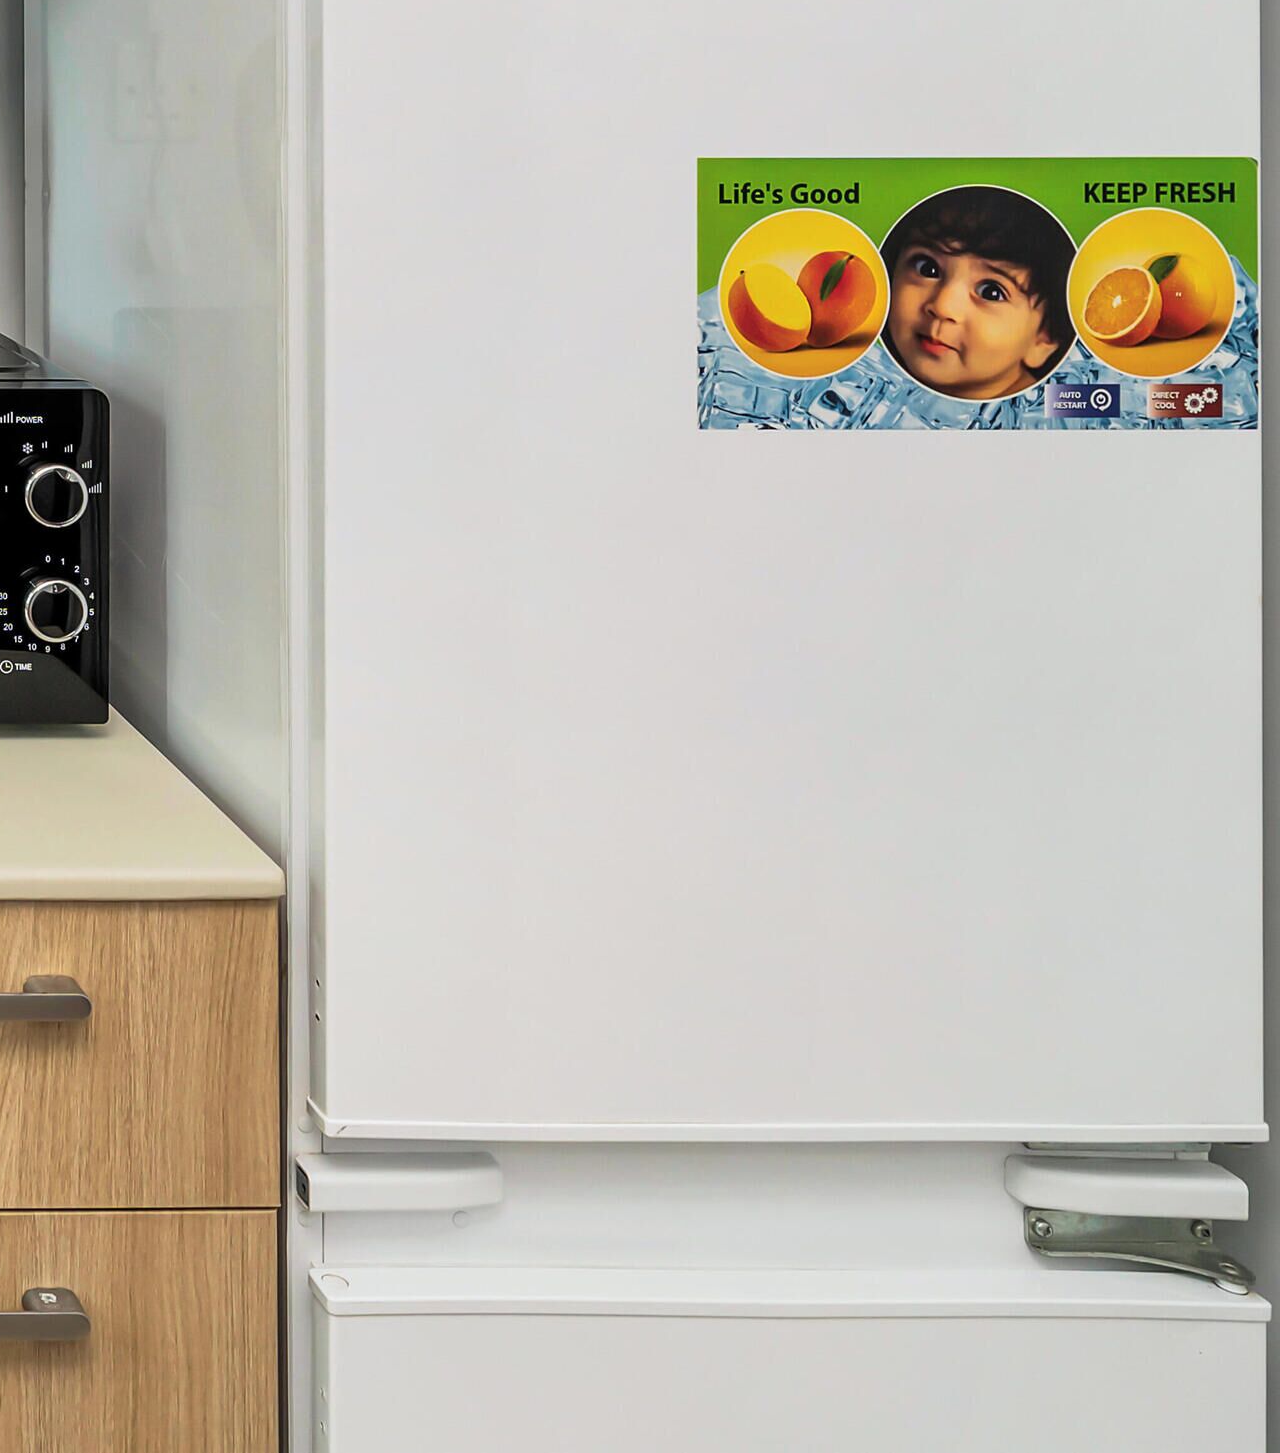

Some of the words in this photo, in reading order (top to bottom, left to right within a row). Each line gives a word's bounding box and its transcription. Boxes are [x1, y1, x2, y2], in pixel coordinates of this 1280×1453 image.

[718, 182, 783, 205] Life's
[790, 181, 860, 204] Good
[1084, 182, 1148, 203] KEEP
[1155, 182, 1236, 203] FRESH
[1053, 401, 1088, 409] RESTART
[15, 416, 43, 424] POWER
[45, 555, 51, 563] 0
[74, 565, 80, 573] 2
[83, 578, 90, 586] 3
[89, 592, 95, 600] 4
[89, 608, 95, 616] 5
[3, 623, 13, 631] 20
[83, 623, 90, 631] 6
[13, 635, 23, 643] 15
[74, 635, 80, 643] 7
[27, 643, 37, 651] 10
[45, 645, 51, 653] 9
[14, 663, 33, 671] TIME
